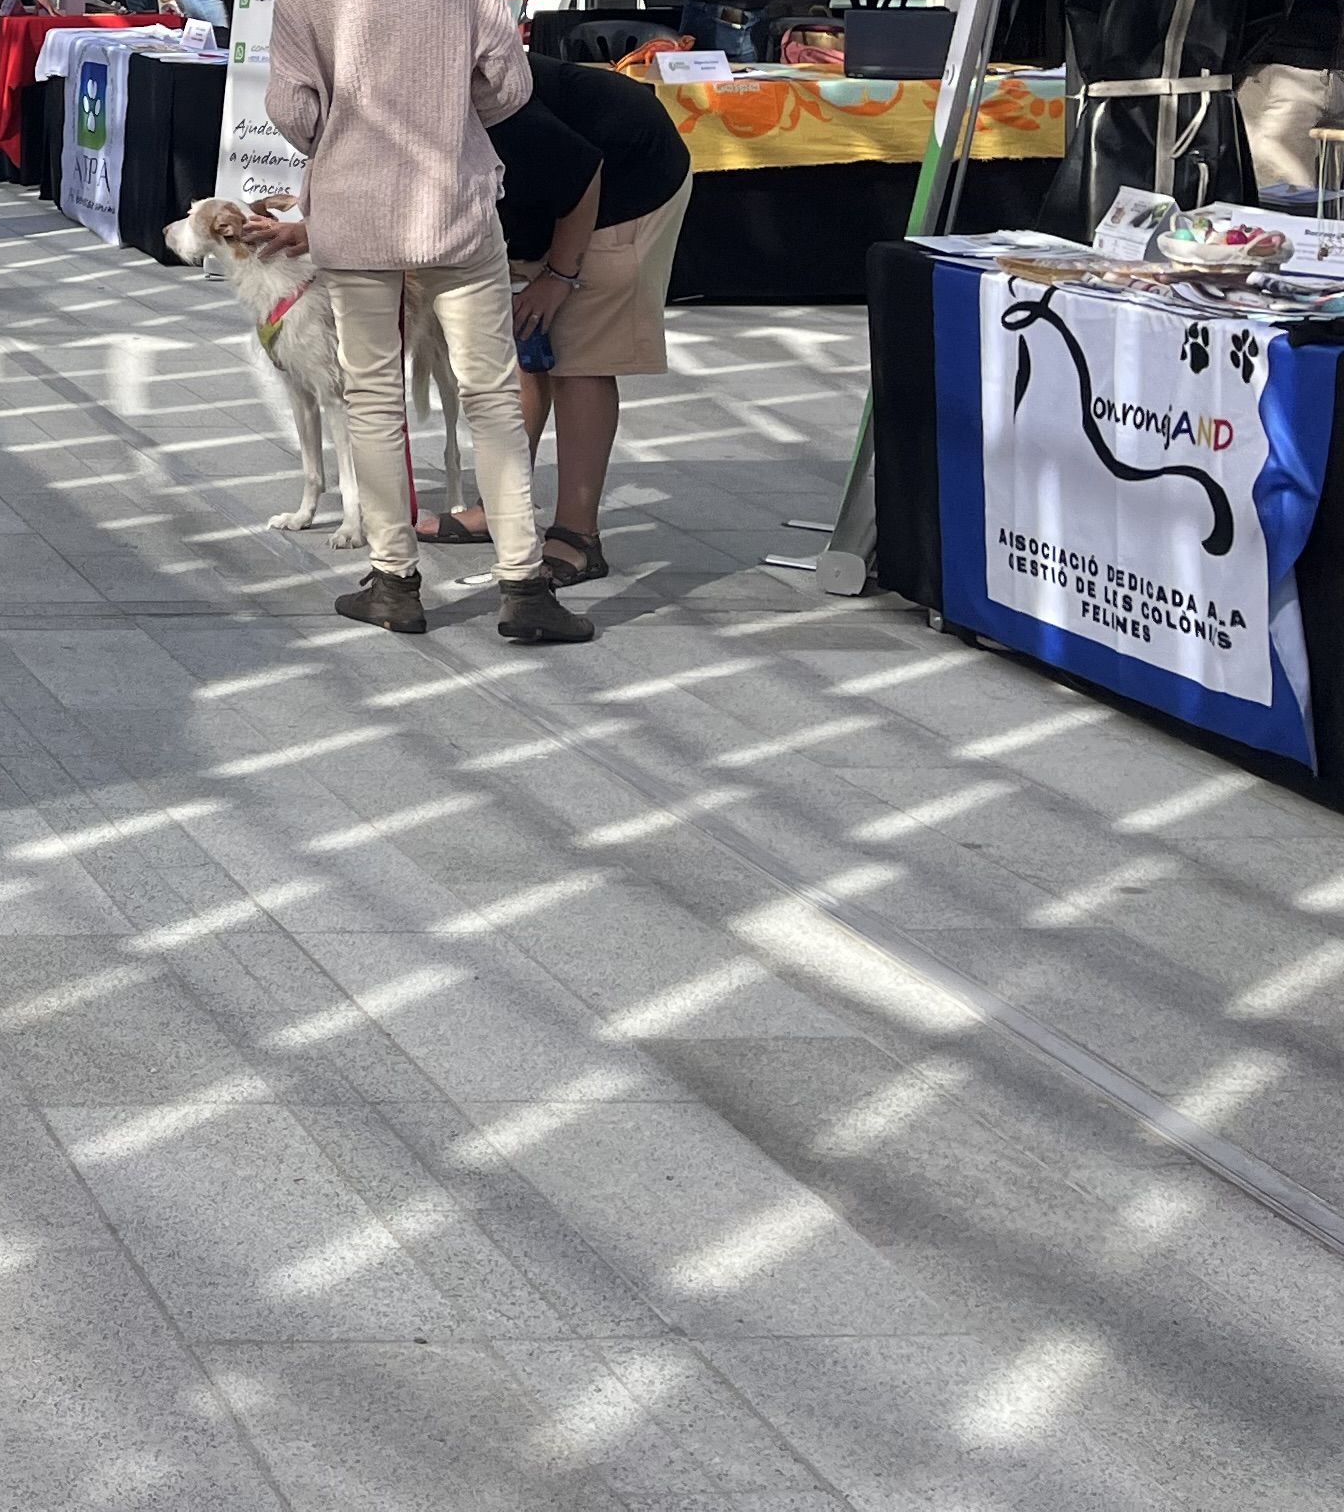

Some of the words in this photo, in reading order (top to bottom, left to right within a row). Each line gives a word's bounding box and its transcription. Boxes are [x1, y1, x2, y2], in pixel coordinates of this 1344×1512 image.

[229, 152, 237, 162] a
[240, 149, 307, 169] ajudar-los
[1075, 575, 1097, 600] DE
[1140, 600, 1233, 650] COLÒNIS
[1106, 564, 1198, 615] DEDICADA
[1081, 600, 1151, 643] FELINES
